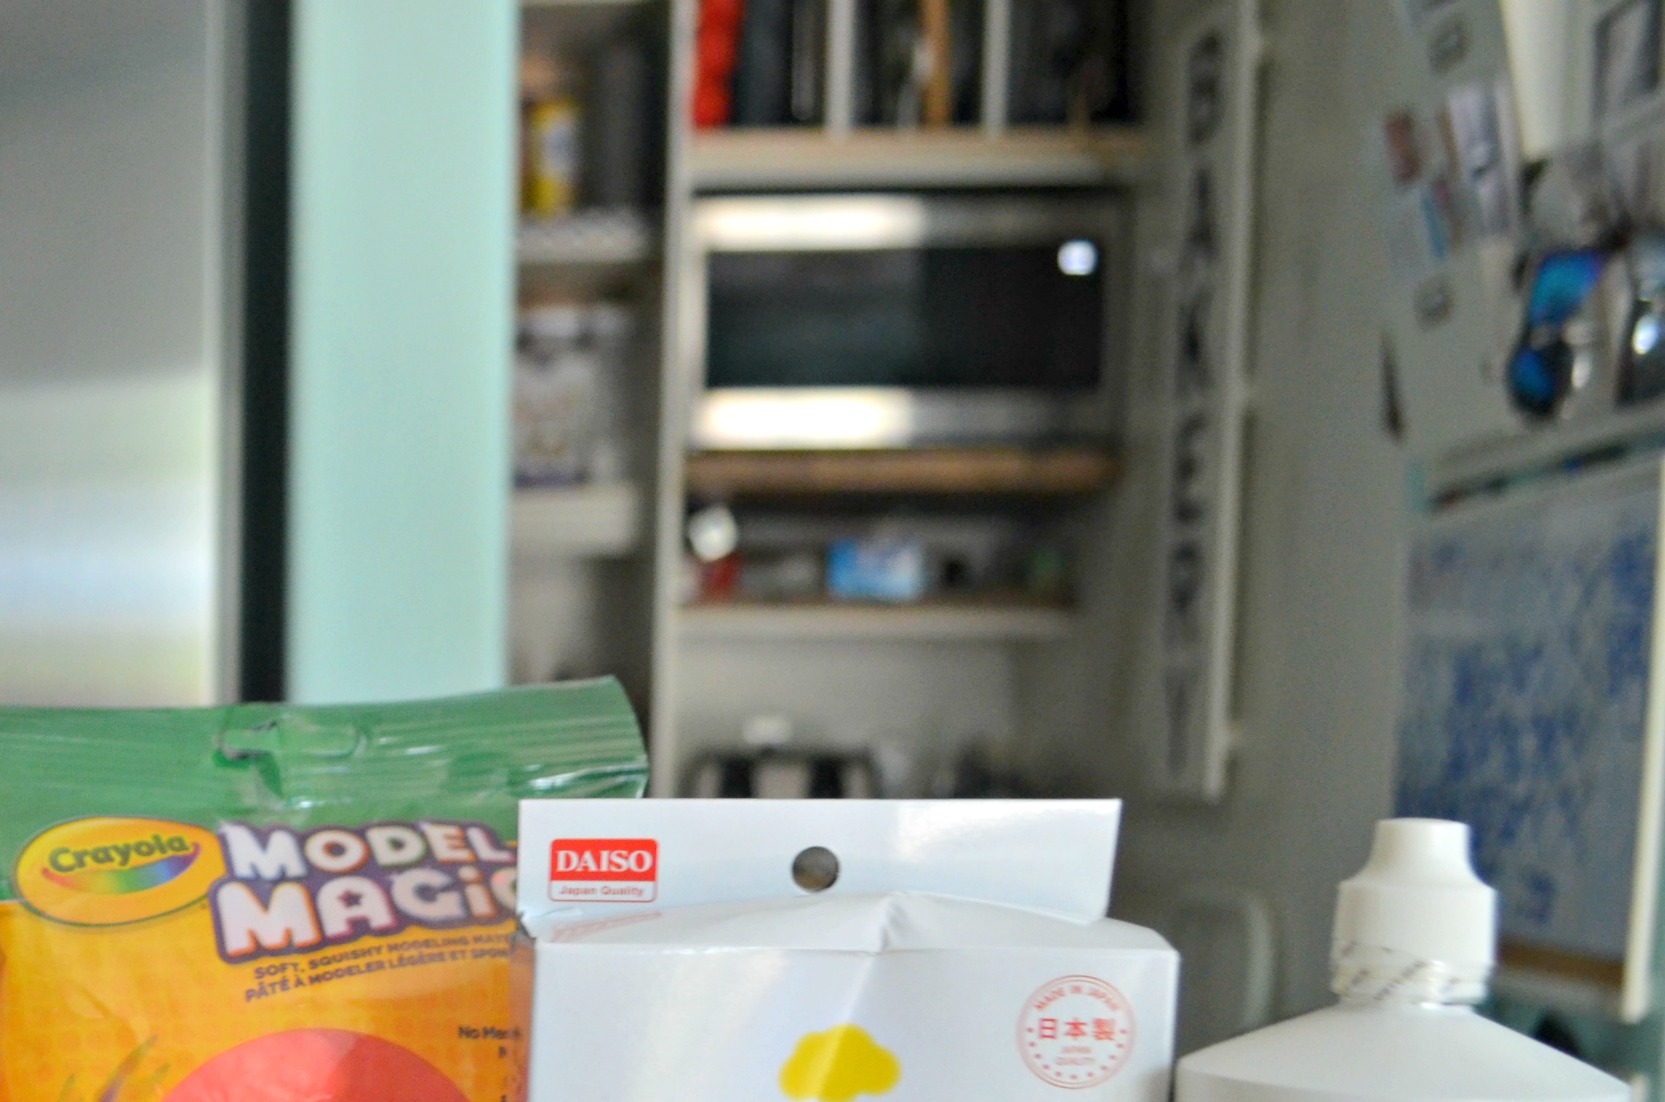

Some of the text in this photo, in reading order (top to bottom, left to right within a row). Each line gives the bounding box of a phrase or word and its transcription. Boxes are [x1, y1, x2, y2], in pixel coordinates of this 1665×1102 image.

[47, 831, 192, 874] Crayola
[221, 822, 516, 881] MODEL
[556, 849, 654, 873] DAISO
[559, 884, 596, 897] Japan
[309, 945, 384, 970] SQUISHY
[388, 935, 470, 955] MODELING
[308, 960, 386, 986] MODELER
[1038, 1017, 1116, 1041] 日本製
